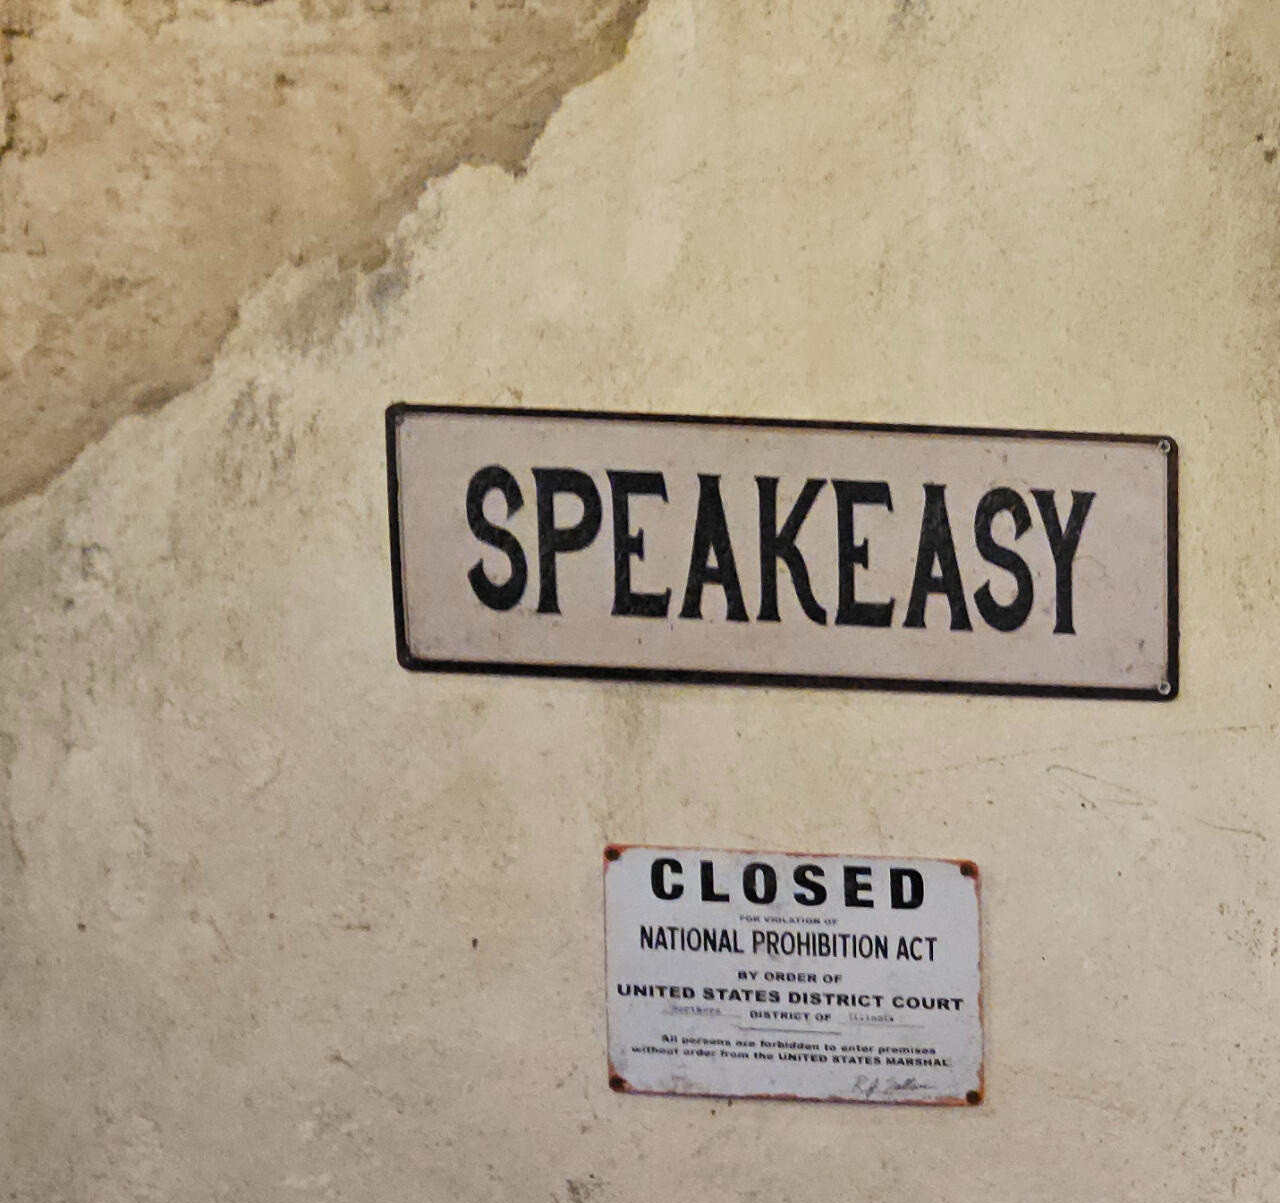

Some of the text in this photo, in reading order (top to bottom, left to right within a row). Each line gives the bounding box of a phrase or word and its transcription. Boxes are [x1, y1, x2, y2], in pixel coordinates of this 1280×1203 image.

[465, 464, 1097, 635] SPEAKEASY
[650, 857, 925, 910] CLOSED
[739, 914, 838, 926] FOR VIOLATION OF
[640, 924, 938, 962] NATIONAL PROHIBITION ACT
[737, 970, 843, 984] BY ORDER OF
[616, 983, 964, 1011] UNITED STATES DISTRICT COURT
[749, 1009, 811, 1021] DISTRICT
[814, 1012, 832, 1022] OF
[631, 1045, 679, 1056] without
[683, 1048, 716, 1058] order
[720, 1050, 749, 1060] from
[753, 1051, 774, 1061] the
[778, 1052, 828, 1063] UNITED
[832, 1055, 881, 1066] STATES
[661, 1033, 937, 1056] All persons are forbidden to enter premises
